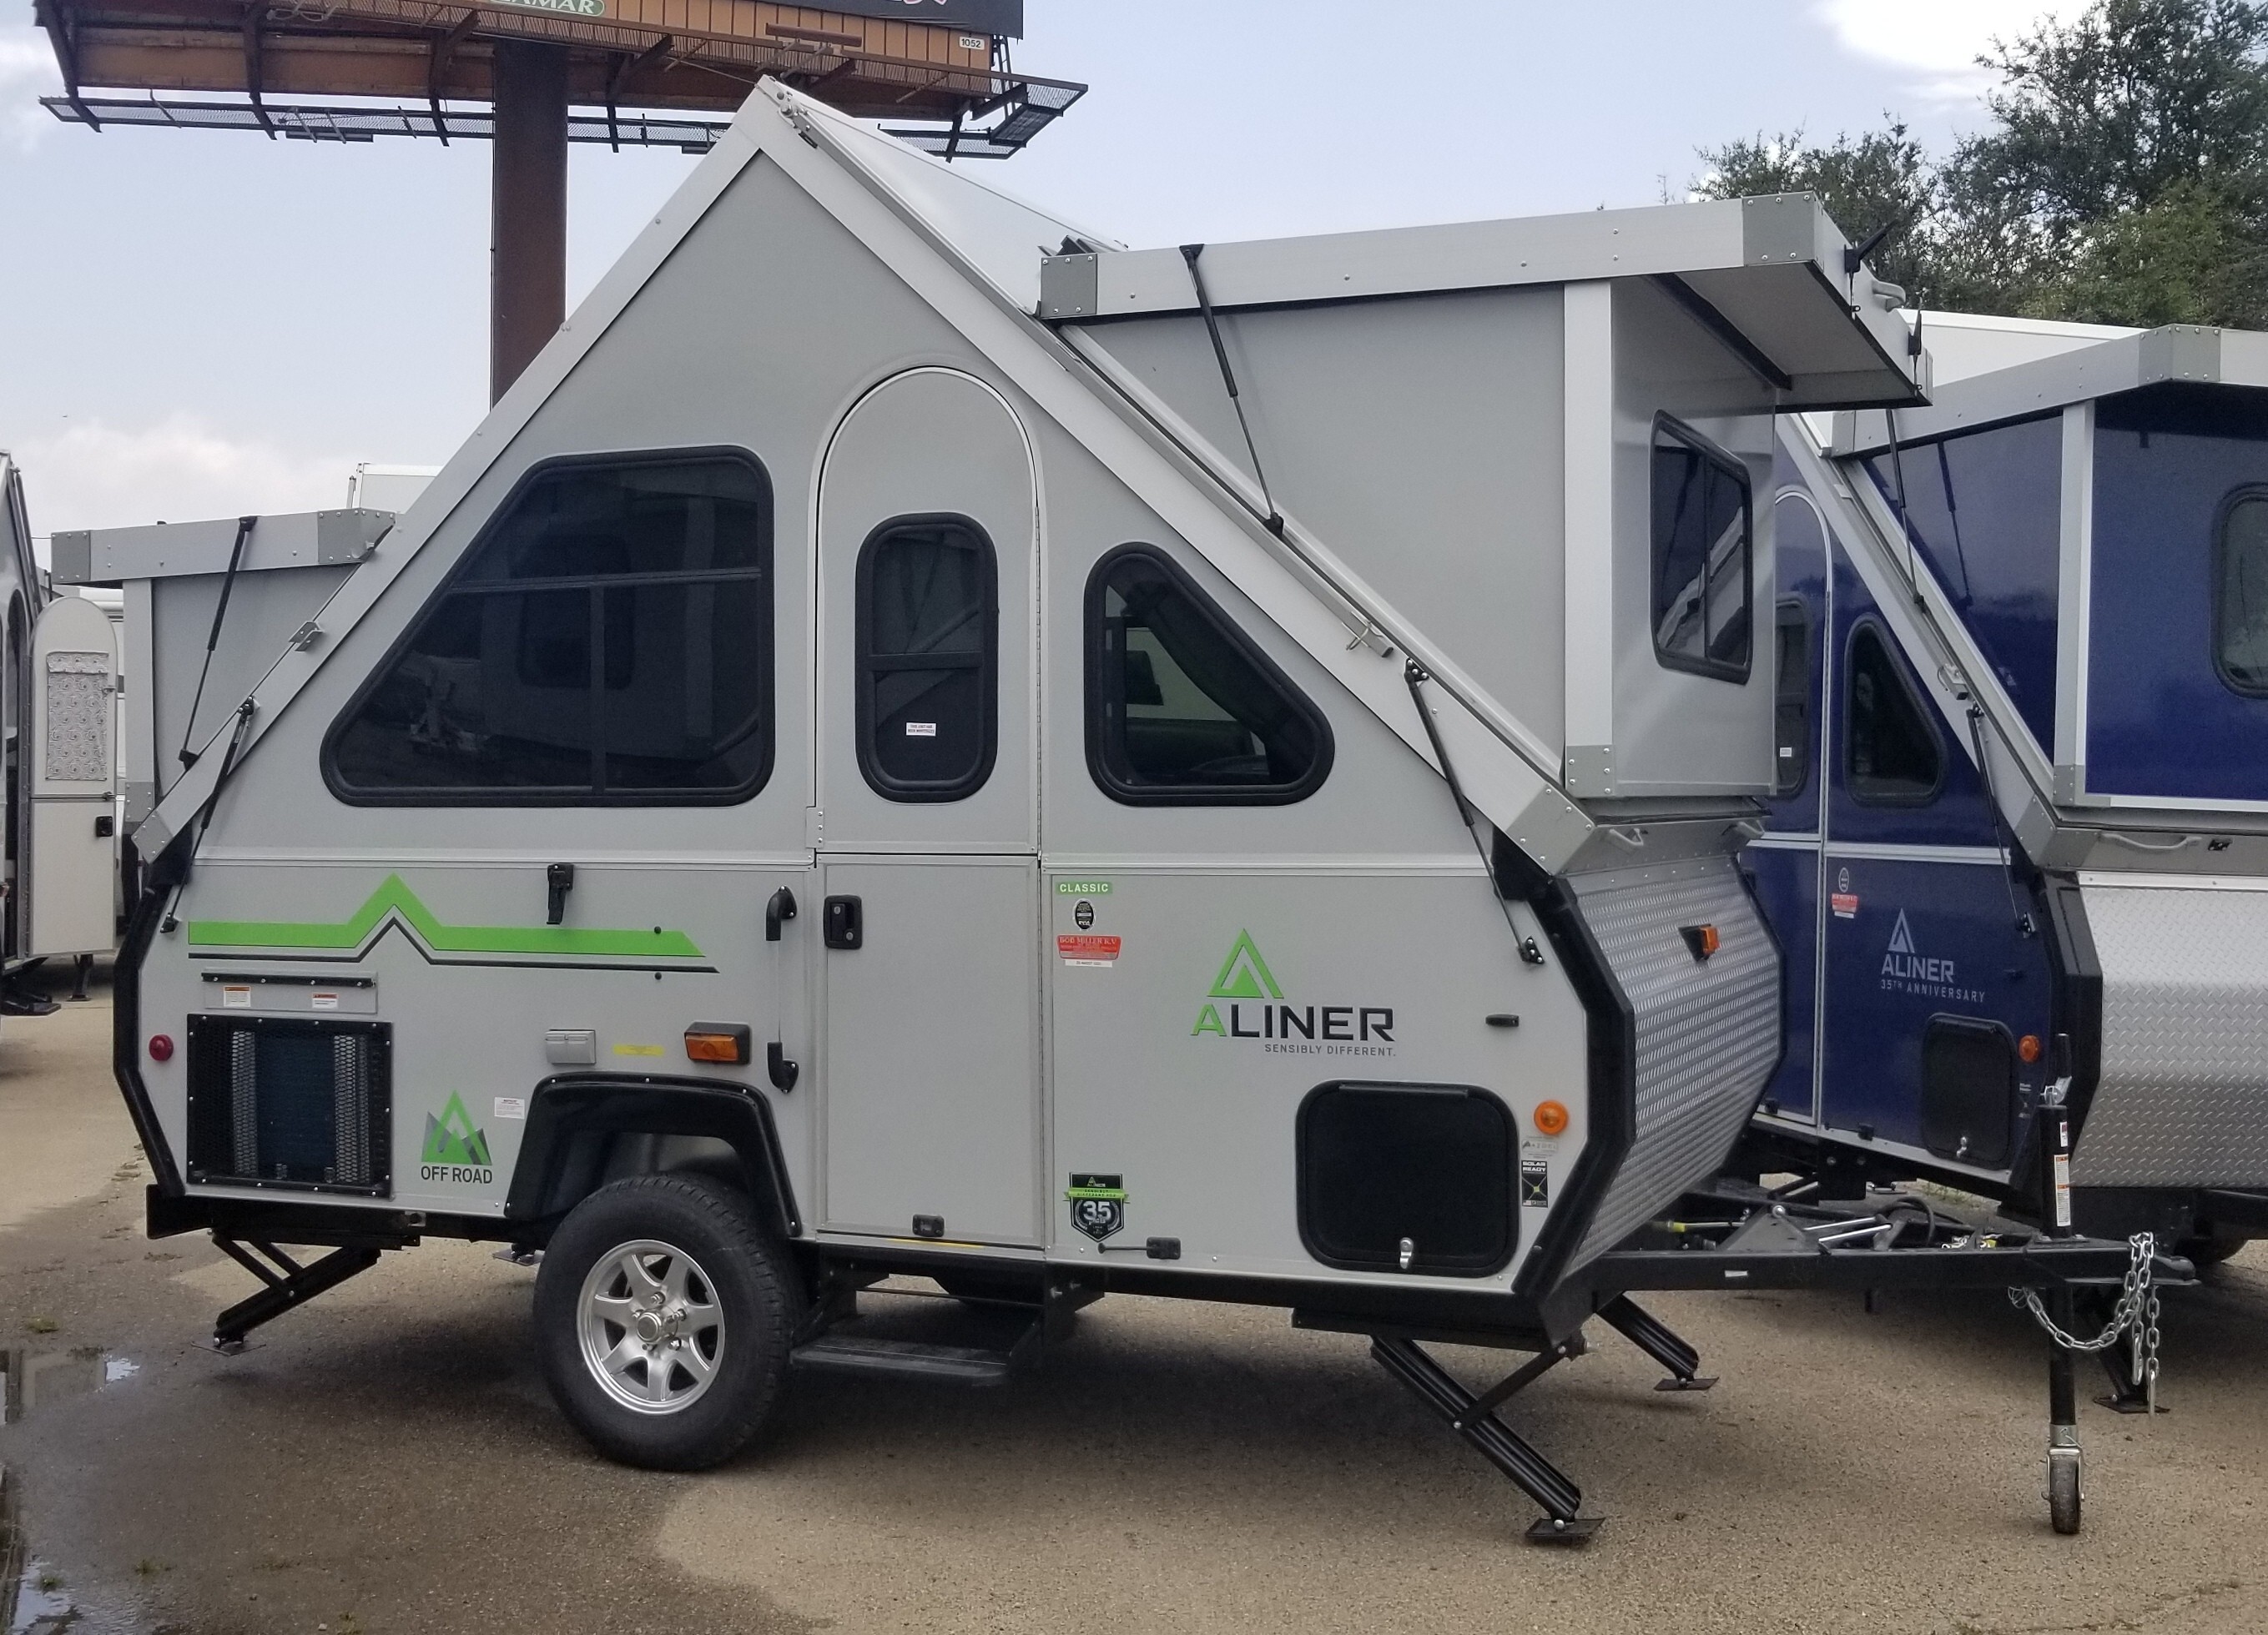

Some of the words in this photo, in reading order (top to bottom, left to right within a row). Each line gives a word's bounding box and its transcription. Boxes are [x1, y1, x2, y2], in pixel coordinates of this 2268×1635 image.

[961, 38, 981, 48] 1052
[1060, 883, 1109, 893] CLASSIC
[1881, 953, 1954, 984] ALINER
[1906, 982, 1985, 1003] ANNIVERSARY
[1189, 1004, 1396, 1042] ALINER
[1264, 1044, 1323, 1055] SENSIBLY
[1327, 1045, 1397, 1057] DIFFERENT.
[421, 1165, 450, 1181] OFF
[452, 1167, 493, 1185] ROAD
[1083, 1201, 1111, 1220] 35
